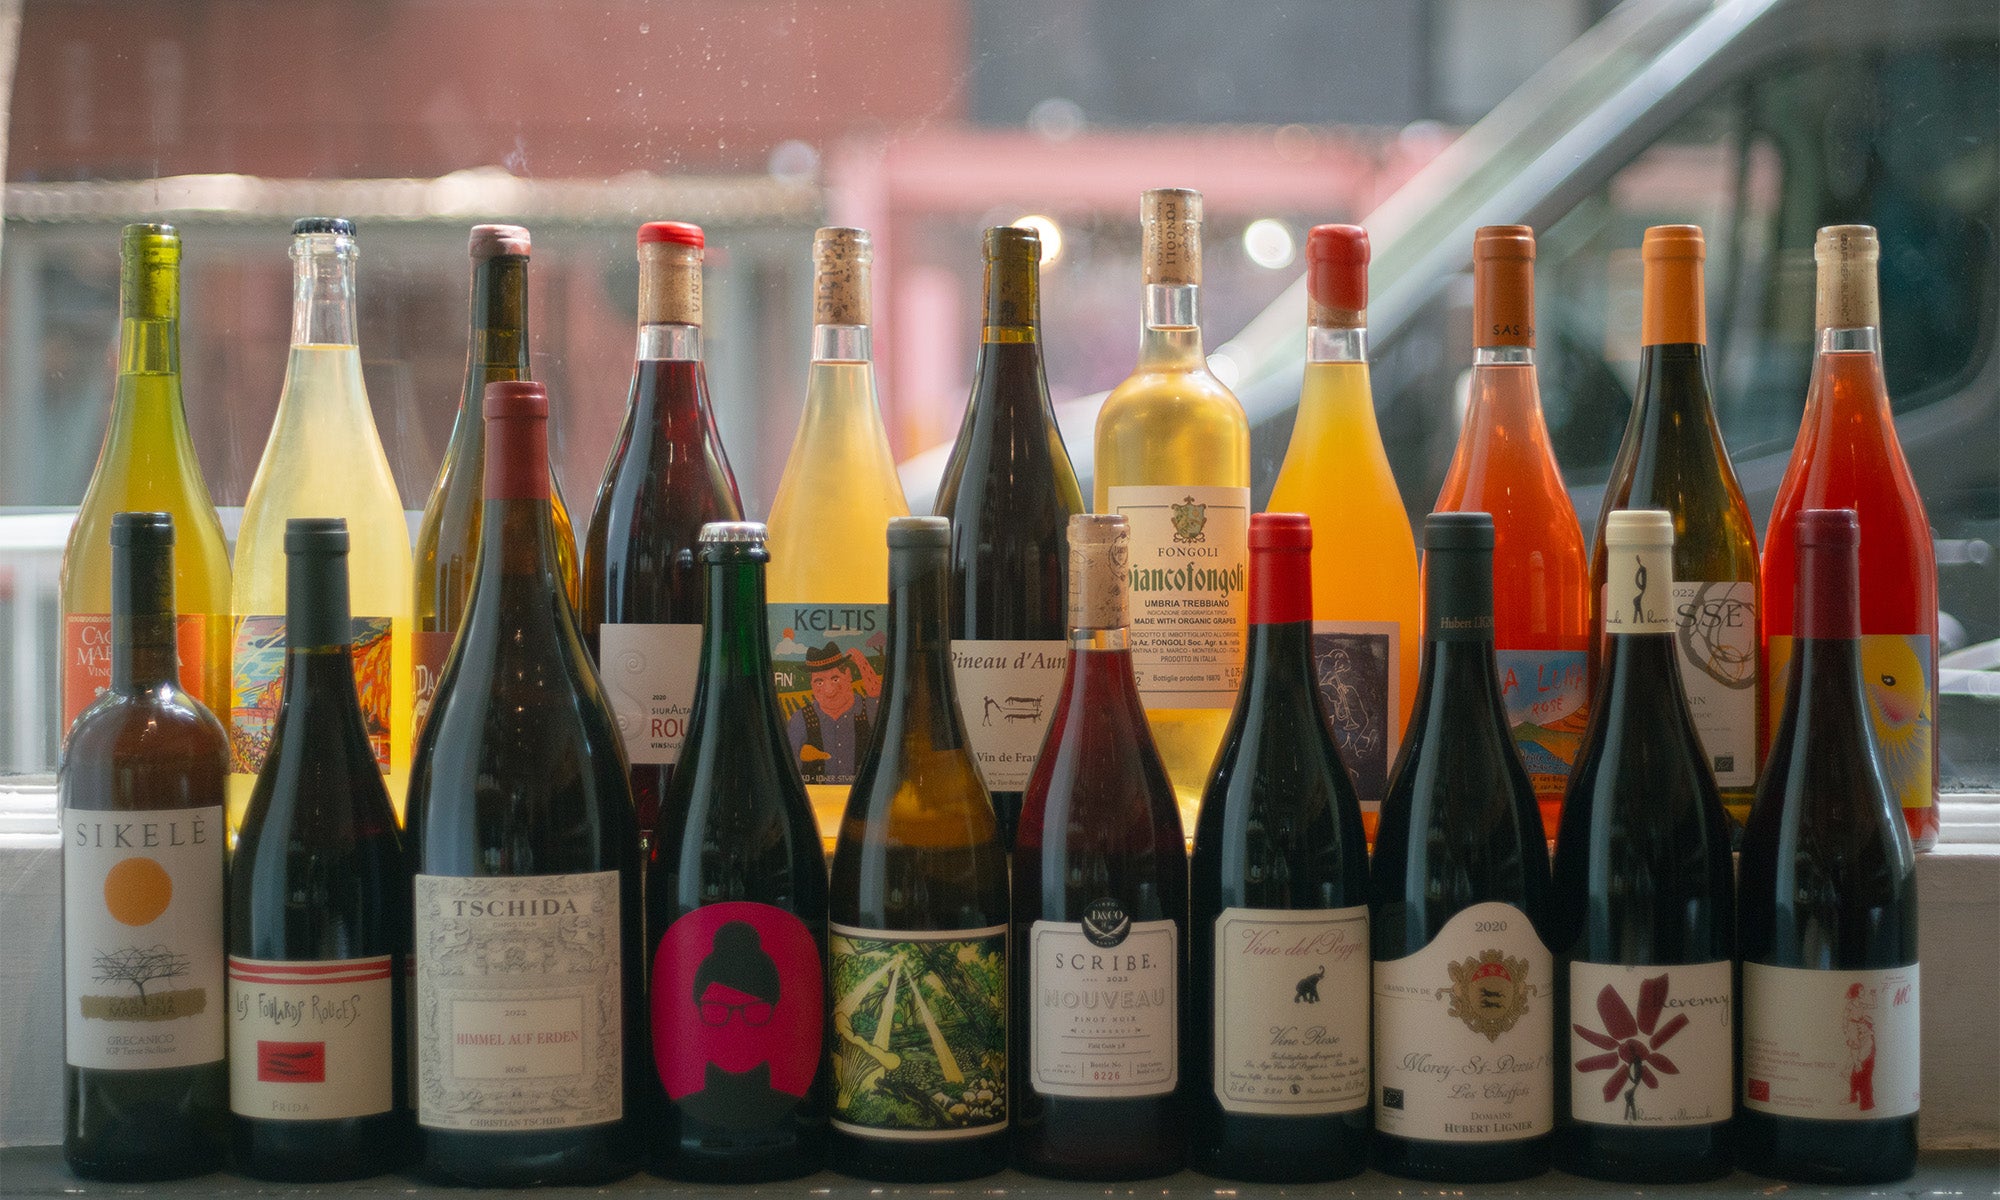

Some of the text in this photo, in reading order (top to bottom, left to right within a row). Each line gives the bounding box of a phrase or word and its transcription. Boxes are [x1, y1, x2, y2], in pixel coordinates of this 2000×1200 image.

[1166, 202, 1176, 265] FONGOLI
[1492, 324, 1520, 336] SAS
[1158, 547, 1218, 557] FONGOLI
[1144, 600, 1180, 608] UMBRIA
[794, 608, 876, 632] KELTIS
[1204, 640, 1217, 648] Agr.
[977, 753, 996, 762] Vin
[999, 752, 1012, 762] de
[76, 815, 207, 848] SIKELÈ
[453, 899, 579, 917] TSCHIDA
[1475, 920, 1508, 932] 2020
[1285, 932, 1320, 956] del
[1043, 987, 1165, 1010] NOUVEAU
[107, 1034, 175, 1045] GRECANICO
[456, 1030, 580, 1046] HIMMEL AUF ERDEN
[1269, 1026, 1298, 1046] Vino
[1094, 1071, 1120, 1080] 8226
[272, 1101, 310, 1112] FRIDA
[469, 1118, 522, 1127] CHRISTIAN
[523, 1117, 566, 1126] TSCHIDA
[1471, 1111, 1513, 1121] DOMAINE
[1444, 1120, 1533, 1134] HUBERT LIGNIER
